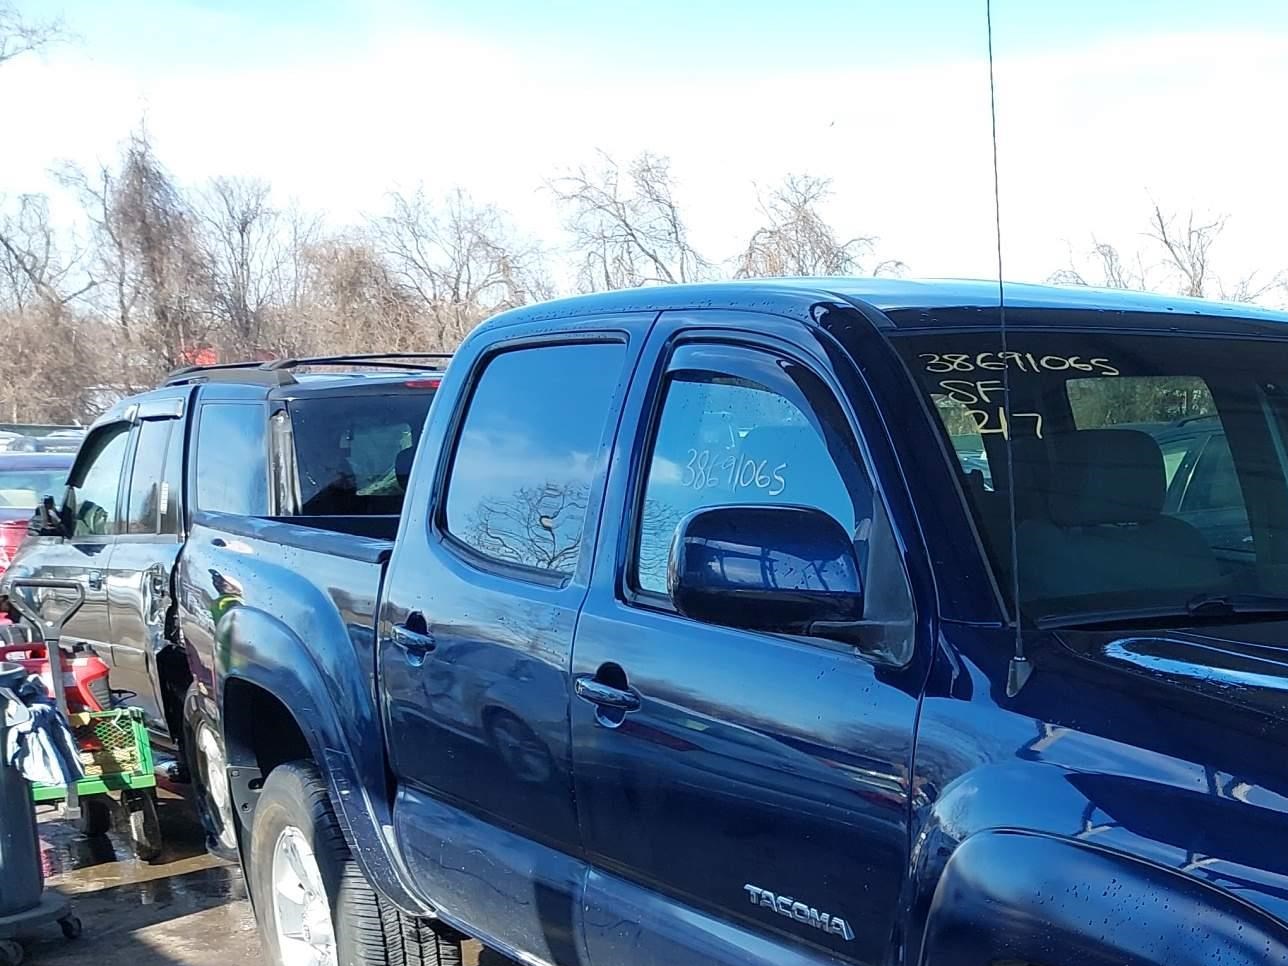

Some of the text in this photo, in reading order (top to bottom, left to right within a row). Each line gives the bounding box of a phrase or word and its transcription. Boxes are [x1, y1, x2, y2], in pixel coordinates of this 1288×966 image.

[919, 351, 1120, 376] 38691065
[682, 448, 788, 496] 38691065
[744, 883, 856, 941] TACOMA
